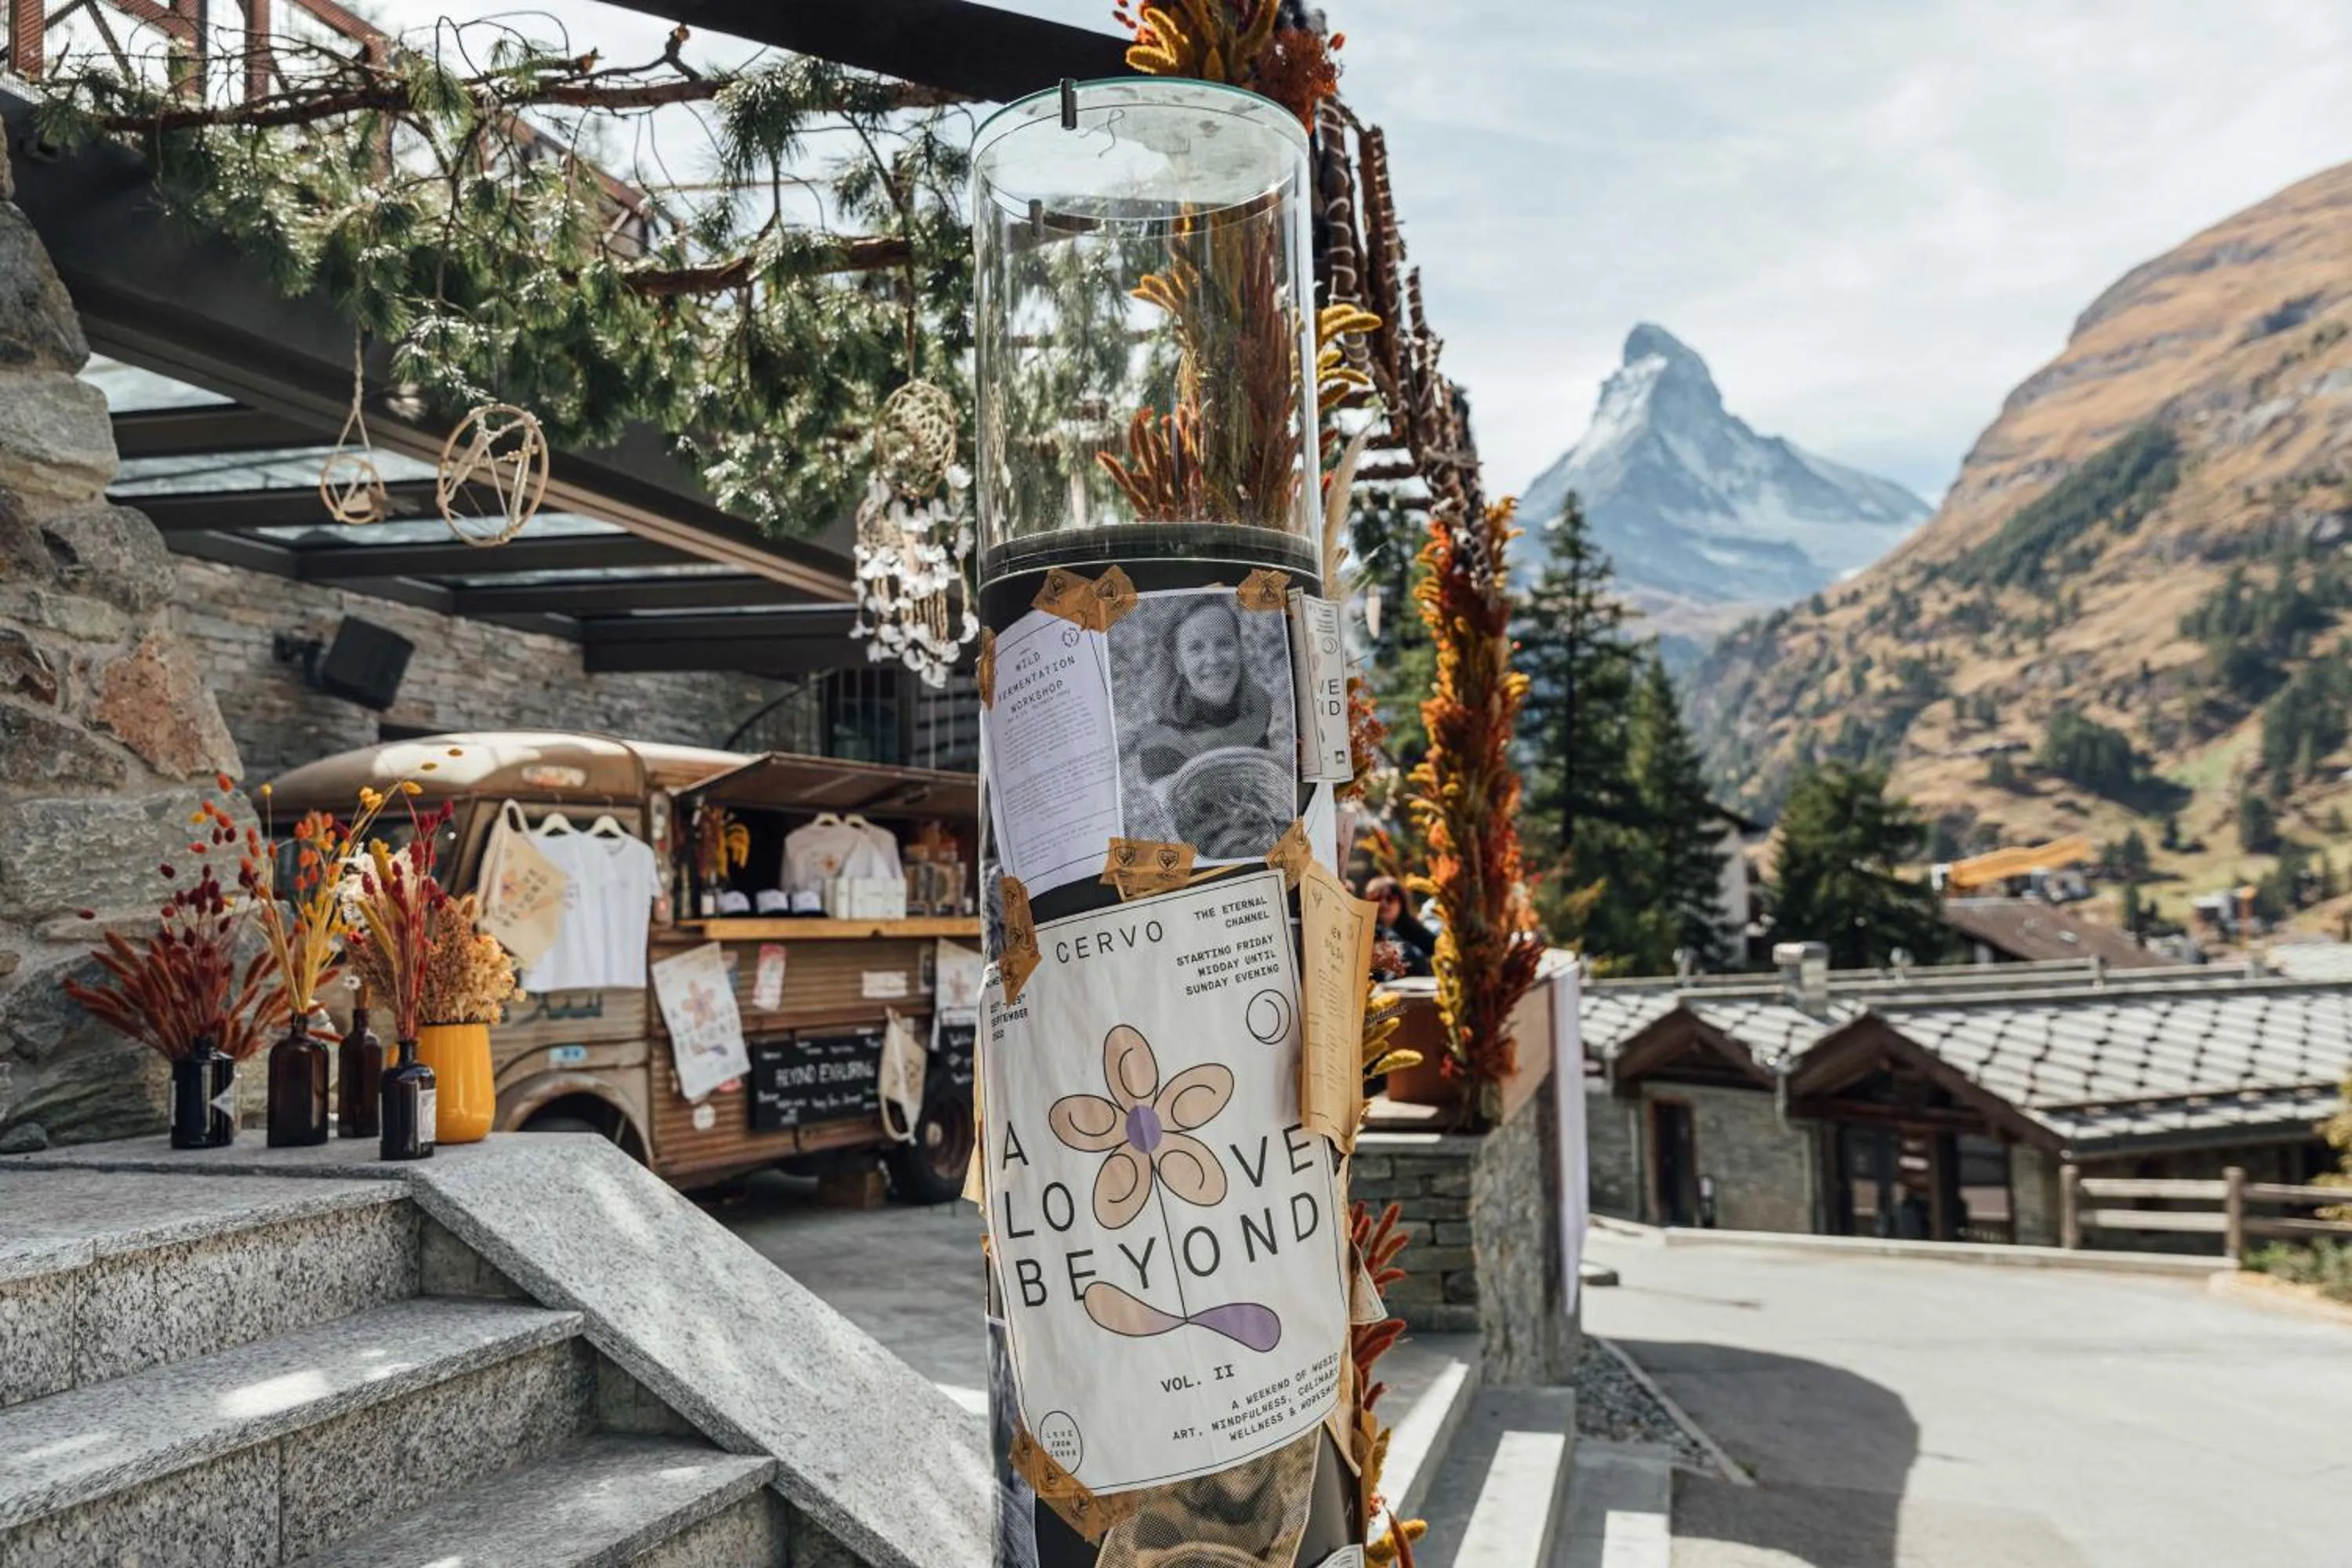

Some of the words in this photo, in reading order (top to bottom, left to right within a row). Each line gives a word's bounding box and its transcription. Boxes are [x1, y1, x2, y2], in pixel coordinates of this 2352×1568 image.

[1015, 652, 1041, 672] WILD
[1010, 679, 1064, 713] WORKSHOP
[1193, 906, 1216, 921] THE
[1221, 896, 1268, 915] ETERNAL
[1225, 910, 1270, 929] CHANNEL
[1056, 920, 1163, 964] CERVO
[1176, 945, 1232, 967] STARTING
[1236, 934, 1274, 952] FRIDAY
[1185, 977, 1229, 996] SUNDAY
[1235, 963, 1280, 984] EVENING
[1197, 958, 1240, 978] MIDDAY
[1244, 949, 1276, 966] UNTIL
[1002, 1120, 1029, 1171] A
[1015, 1191, 1319, 1308] BEYOND
[1160, 1374, 1202, 1394] VOL.
[1213, 1363, 1236, 1381] II
[1231, 1399, 1240, 1410] A
[1245, 1378, 1290, 1405] WEEKEND
[1295, 1369, 1307, 1382] OF
[1172, 1427, 1203, 1441] ART,
[1211, 1394, 1292, 1432] MINDFULNESS,
[1229, 1412, 1284, 1442] WELLNESS
